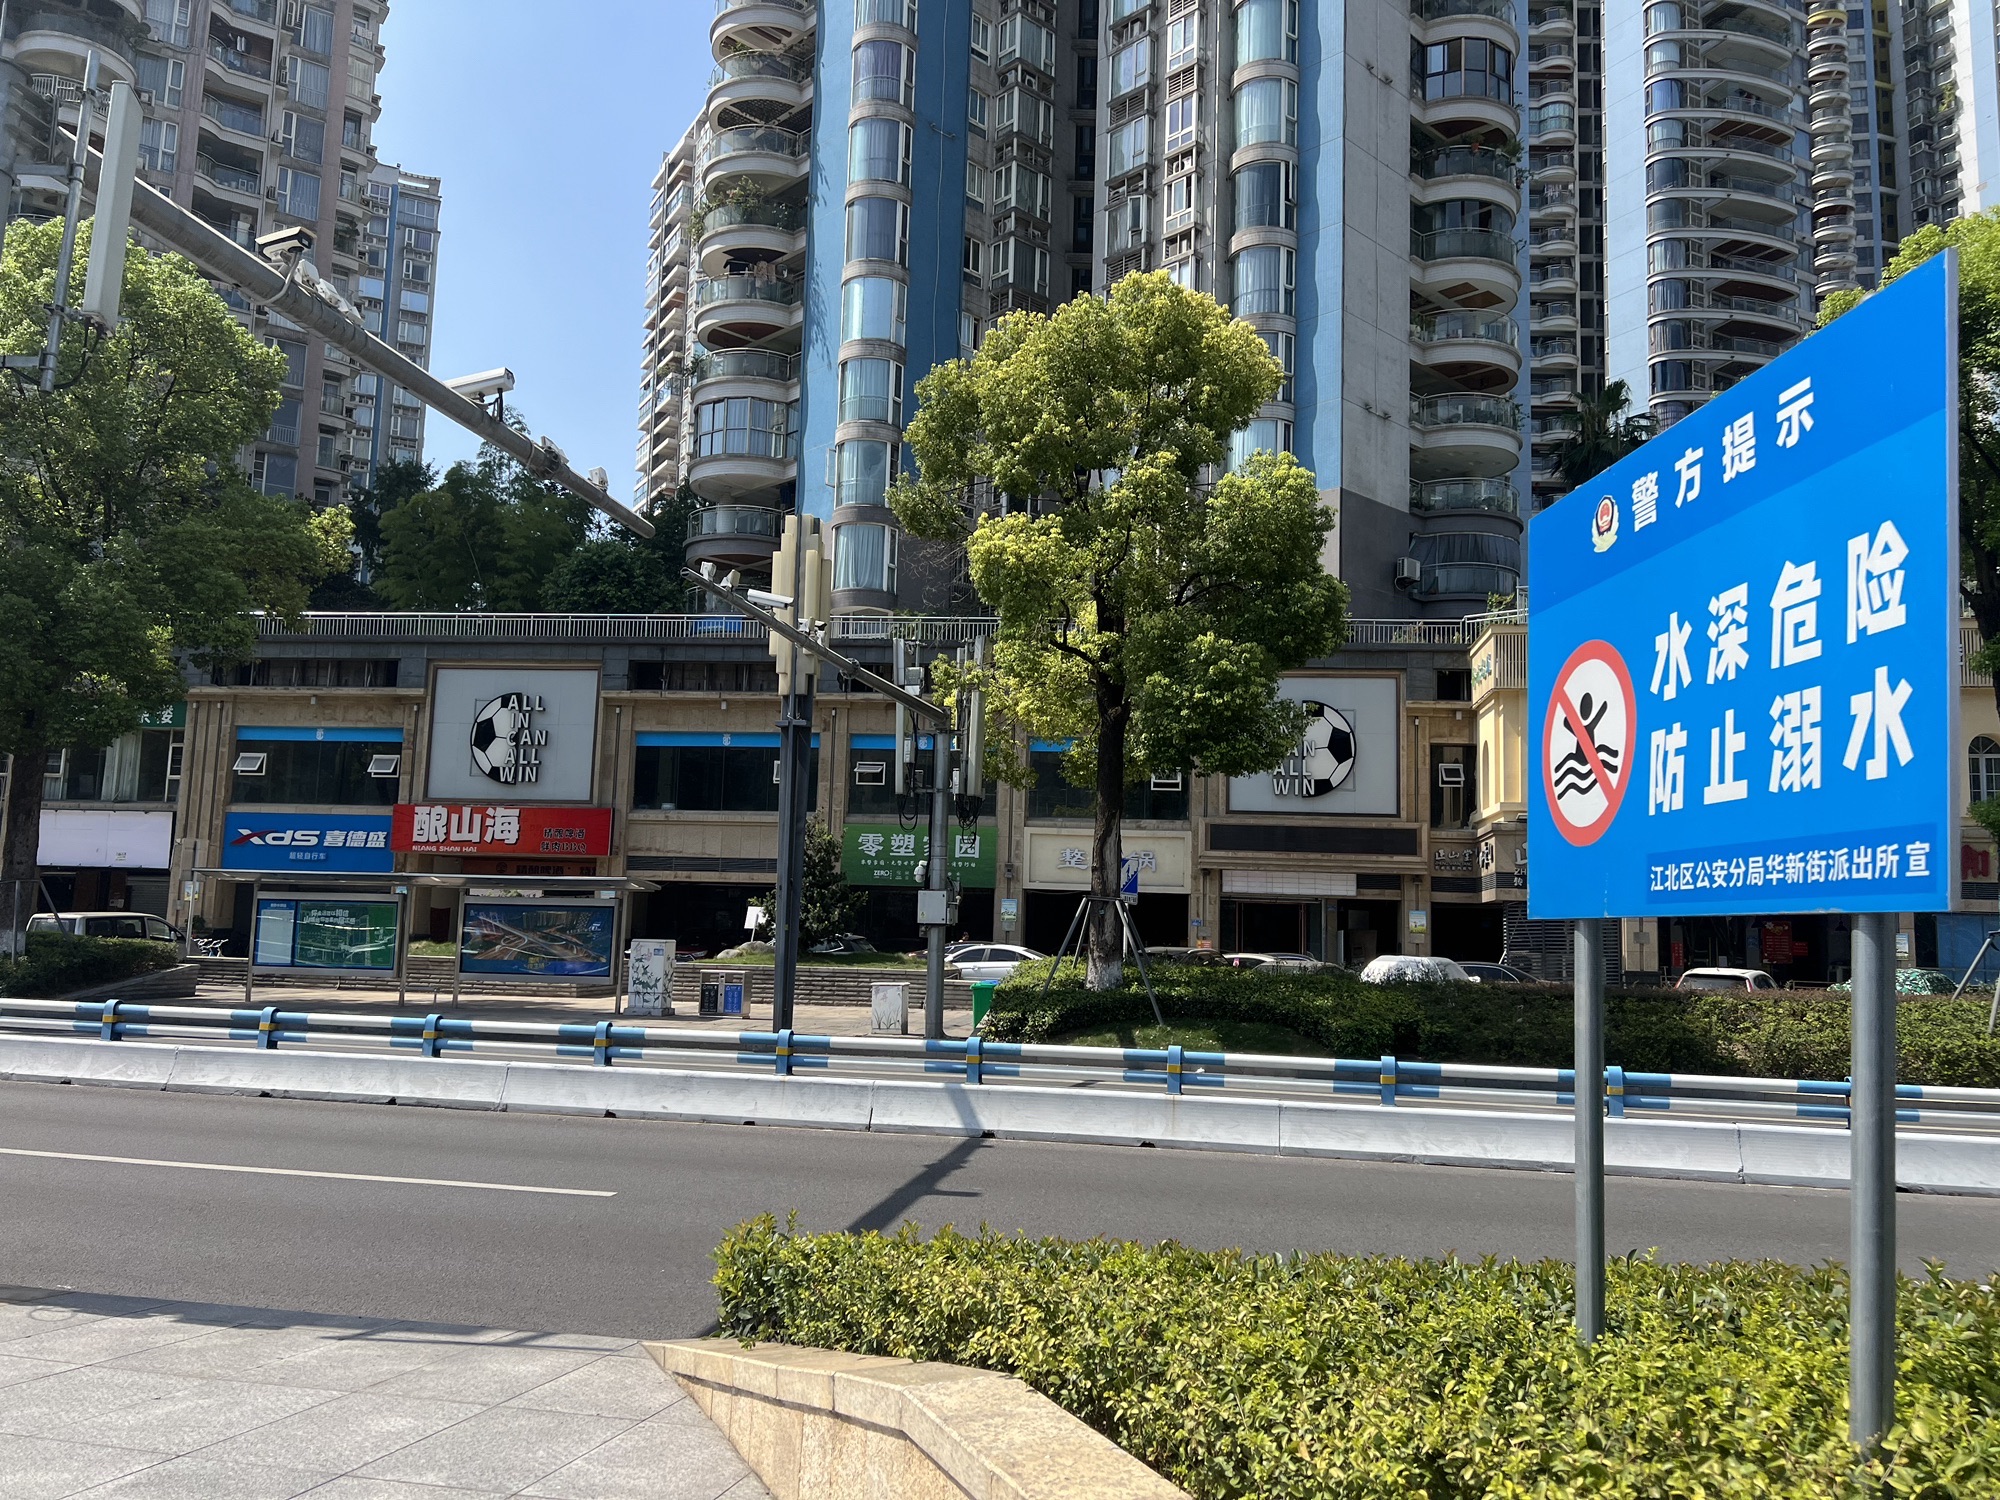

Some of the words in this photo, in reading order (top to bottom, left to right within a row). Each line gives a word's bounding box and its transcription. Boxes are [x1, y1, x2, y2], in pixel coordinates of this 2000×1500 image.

[1631, 376, 1815, 533] 警方提示
[1649, 519, 1910, 702] 水深危险
[508, 695, 544, 711] ALL
[511, 713, 529, 728] IN
[507, 730, 546, 746] CAN
[1648, 665, 1914, 816] 防止溺水
[505, 749, 539, 764] ALL
[500, 766, 537, 783] WIN
[1273, 779, 1315, 796] WIN
[412, 805, 520, 844] 酿山海
[323, 830, 387, 848] 喜德盛
[1650, 844, 1899, 892] 江北区公安分局华新街派出所
[1905, 840, 1930, 877] 宣
